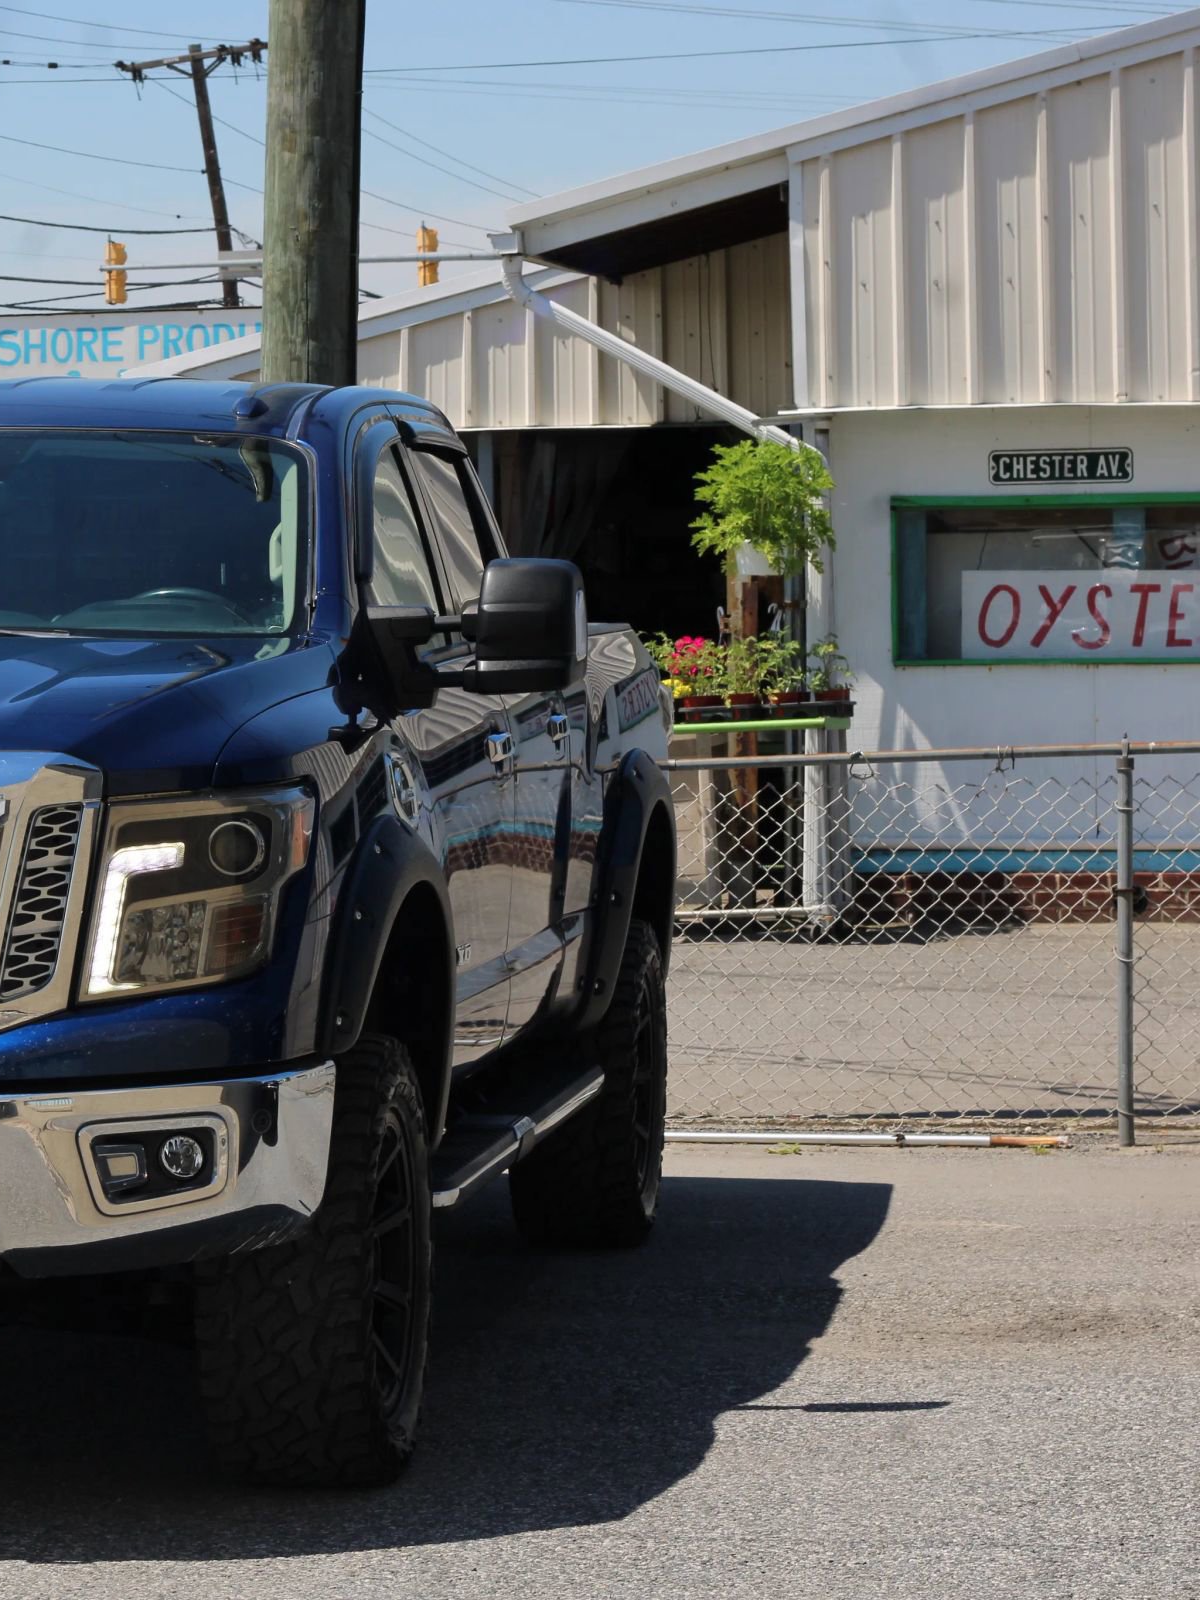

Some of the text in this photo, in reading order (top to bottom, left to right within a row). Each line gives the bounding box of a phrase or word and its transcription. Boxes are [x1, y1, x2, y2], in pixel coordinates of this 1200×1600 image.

[999, 453, 1123, 479] CHESTER AV.
[978, 584, 1200, 649] OYSTE
